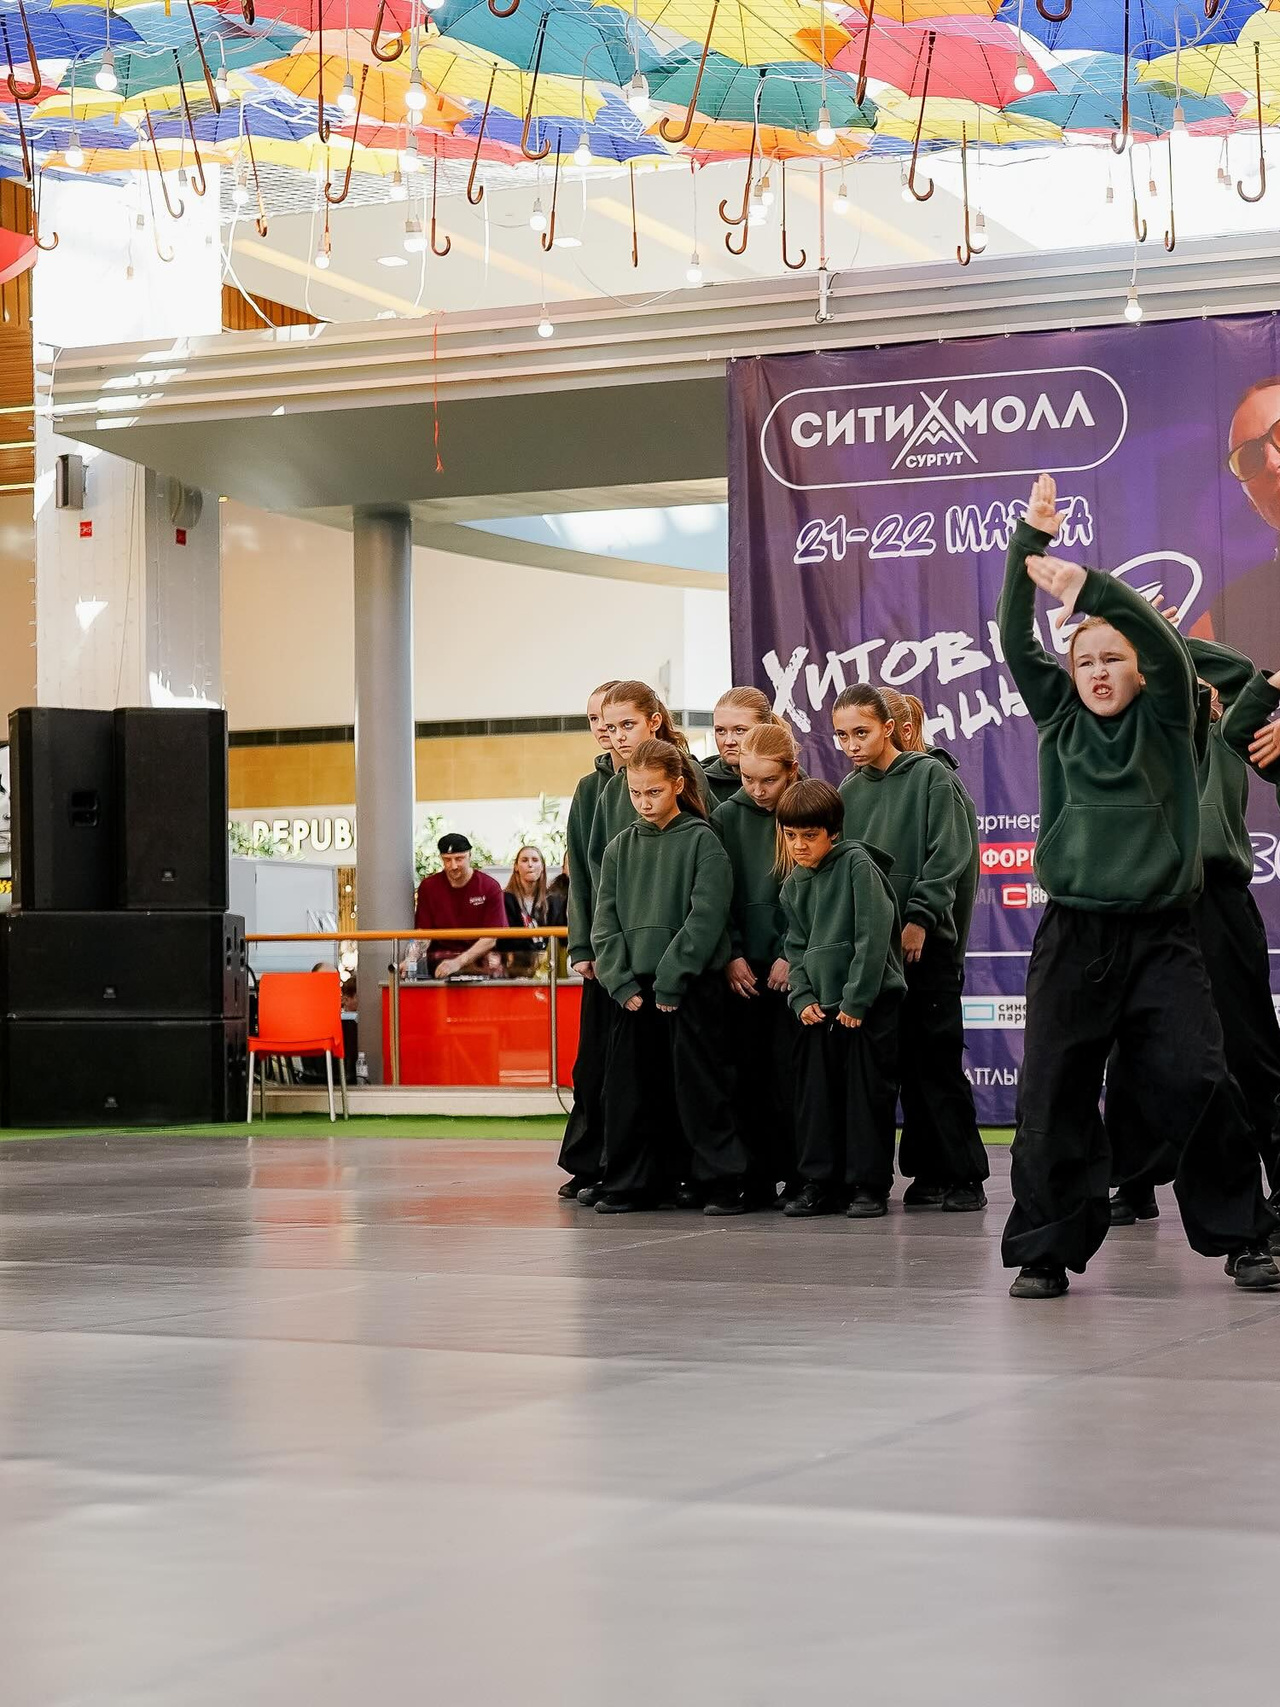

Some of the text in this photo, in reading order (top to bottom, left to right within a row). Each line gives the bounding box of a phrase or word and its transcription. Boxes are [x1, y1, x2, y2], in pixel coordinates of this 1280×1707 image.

[790, 391, 1096, 448] СИТИ МОЛЛ
[905, 451, 964, 468] СУРГУТ
[793, 512, 937, 564] 21-22
[976, 814, 1040, 834] артнер
[252, 818, 357, 852] REPUB
[982, 848, 1035, 868] ФОР
[963, 1067, 1019, 1086] АТТЛЫ
